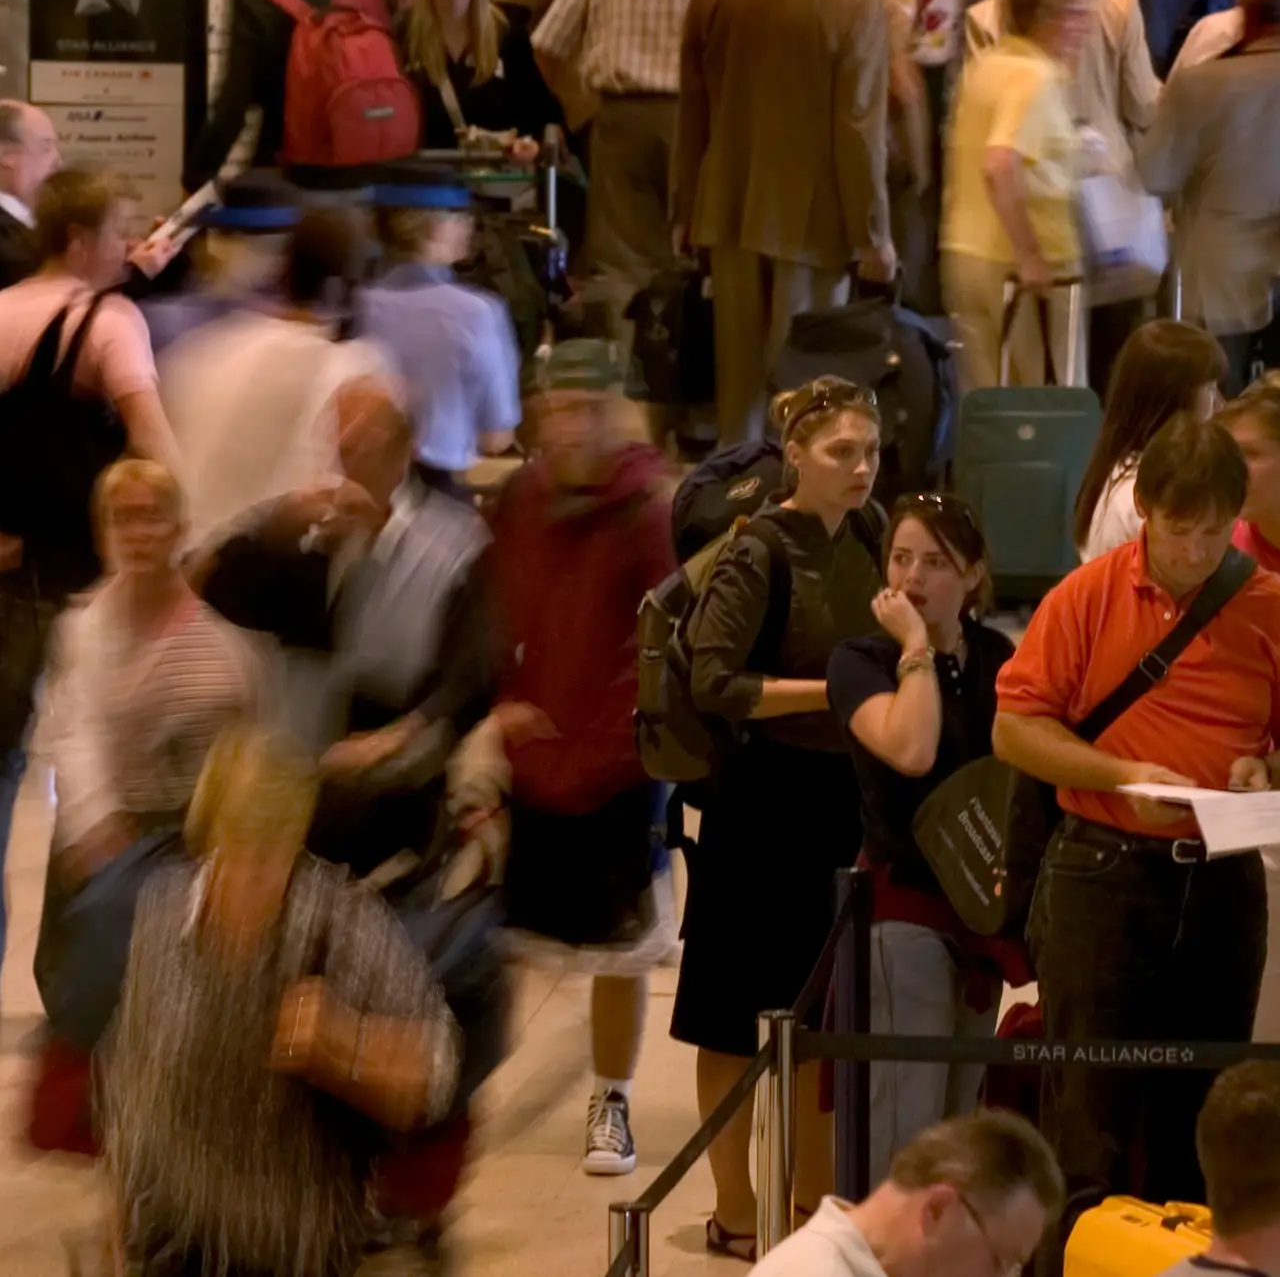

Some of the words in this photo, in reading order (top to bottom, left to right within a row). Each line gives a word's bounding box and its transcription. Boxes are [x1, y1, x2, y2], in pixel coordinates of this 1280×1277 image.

[957, 808, 995, 865] Broadcast
[1013, 1044, 1066, 1061] STAR
[1072, 1045, 1178, 1064] ALLIANCE
